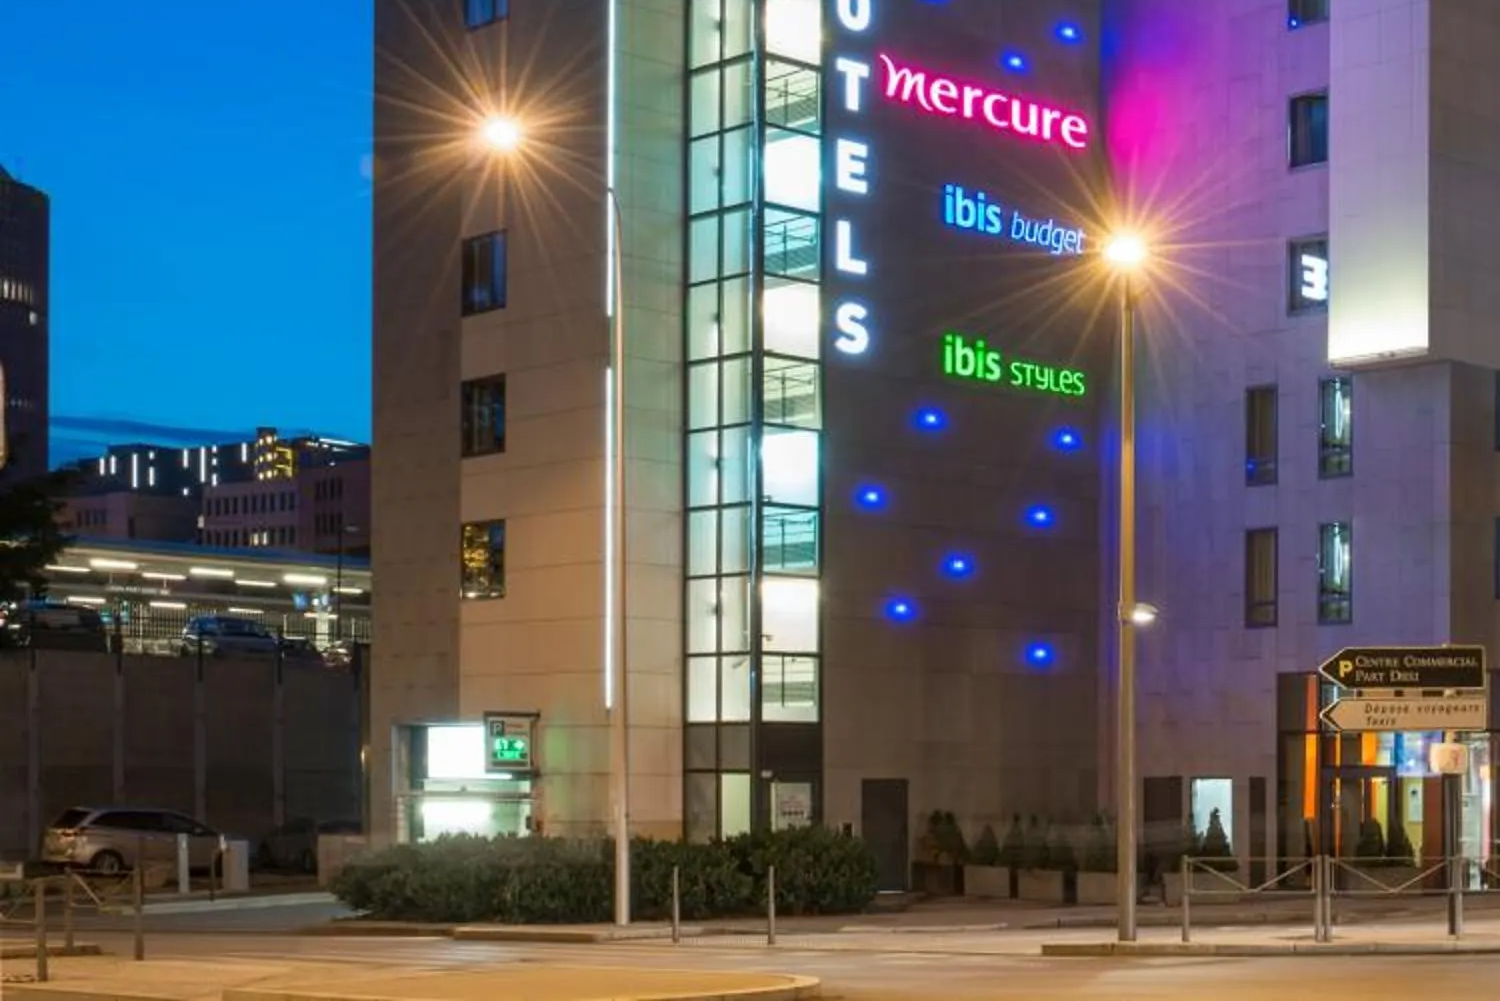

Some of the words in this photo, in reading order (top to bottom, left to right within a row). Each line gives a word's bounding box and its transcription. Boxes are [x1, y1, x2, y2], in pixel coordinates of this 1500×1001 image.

[879, 53, 1088, 148] mercure
[944, 184, 1002, 235] ibis
[1010, 210, 1087, 256] budget
[944, 334, 1002, 382] ibis
[1339, 660, 1353, 678] P
[1355, 670, 1385, 682] PART
